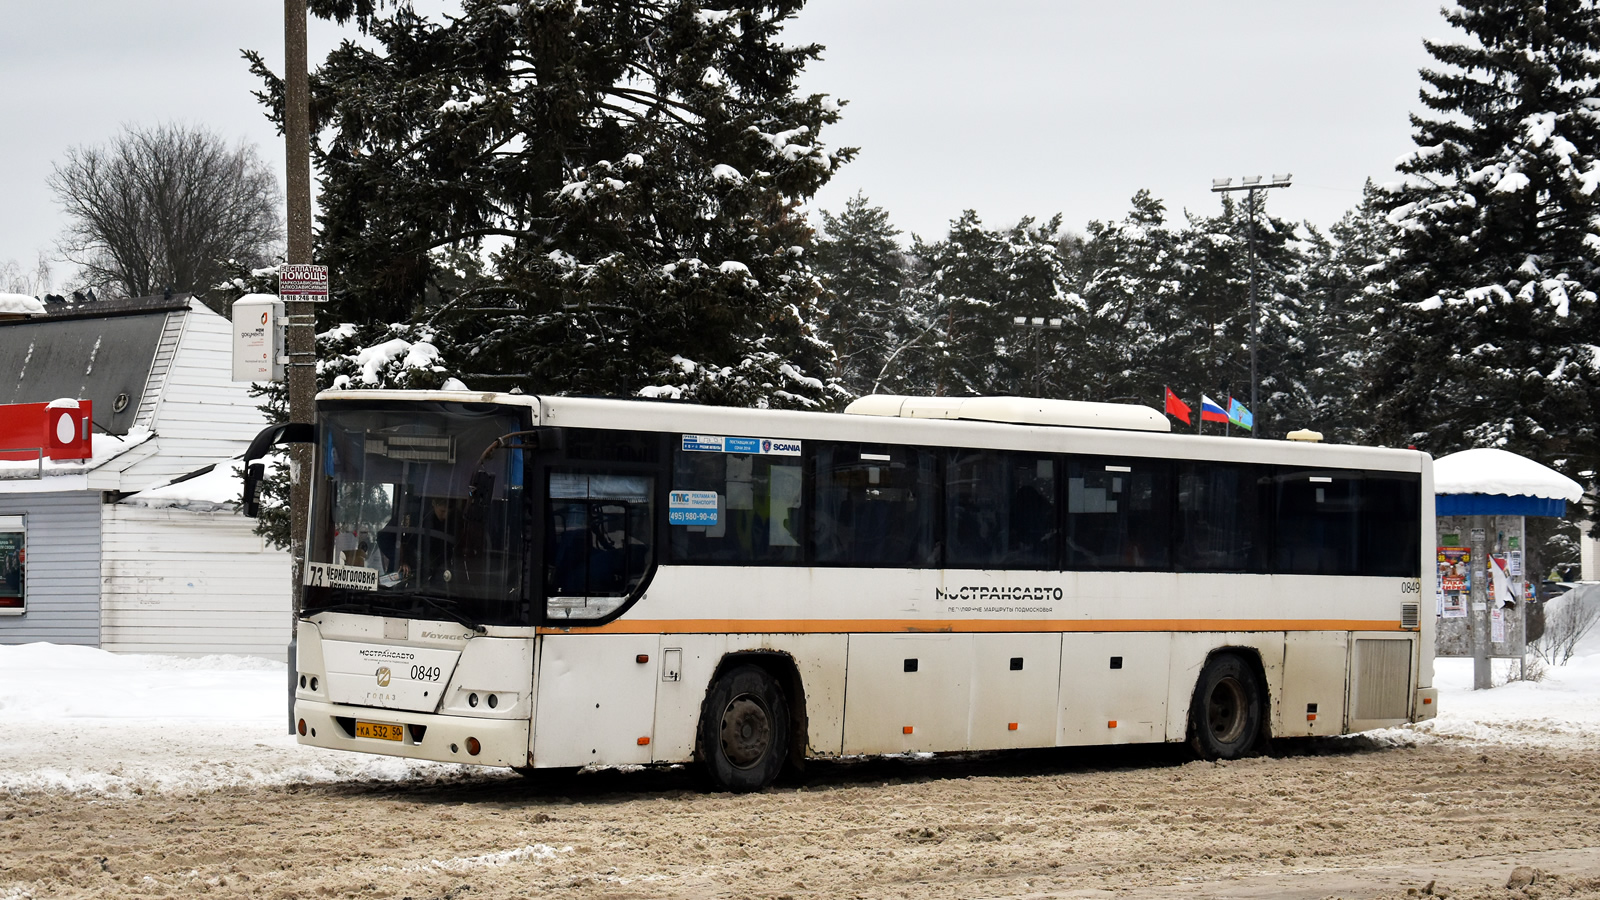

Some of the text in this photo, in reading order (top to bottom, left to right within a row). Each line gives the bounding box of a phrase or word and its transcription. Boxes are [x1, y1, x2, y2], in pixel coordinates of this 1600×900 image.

[281, 272, 326, 281] ПОМОЩЬ
[773, 443, 800, 452] SCANIA
[671, 493, 689, 502] TMG
[685, 512, 717, 521] 980-90-40
[310, 566, 323, 587] 73
[1402, 581, 1420, 593] 0849
[410, 665, 441, 681] 0849
[373, 726, 387, 738] 532
[392, 727, 400, 736] 50
